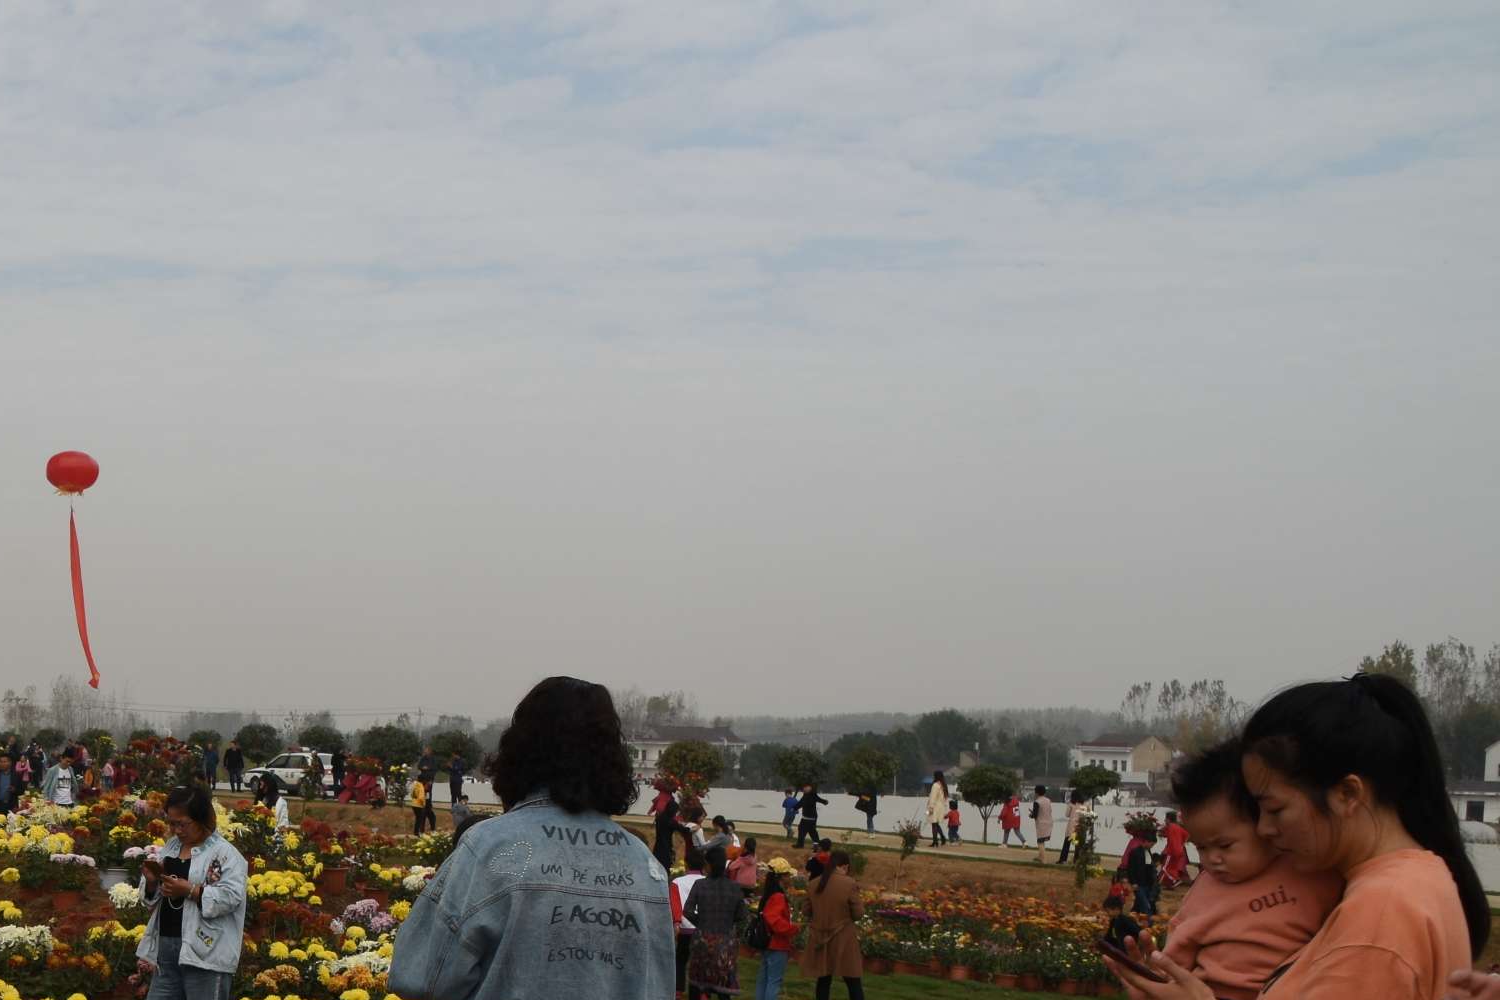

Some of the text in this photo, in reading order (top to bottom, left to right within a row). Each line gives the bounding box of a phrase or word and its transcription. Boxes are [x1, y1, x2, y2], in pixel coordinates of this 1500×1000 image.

[541, 824, 632, 846] VIVI COM
[541, 863, 635, 887] UM PÉ ATRÁS
[550, 904, 642, 934] E AGORA
[547, 946, 625, 970] ESTOU NAS
